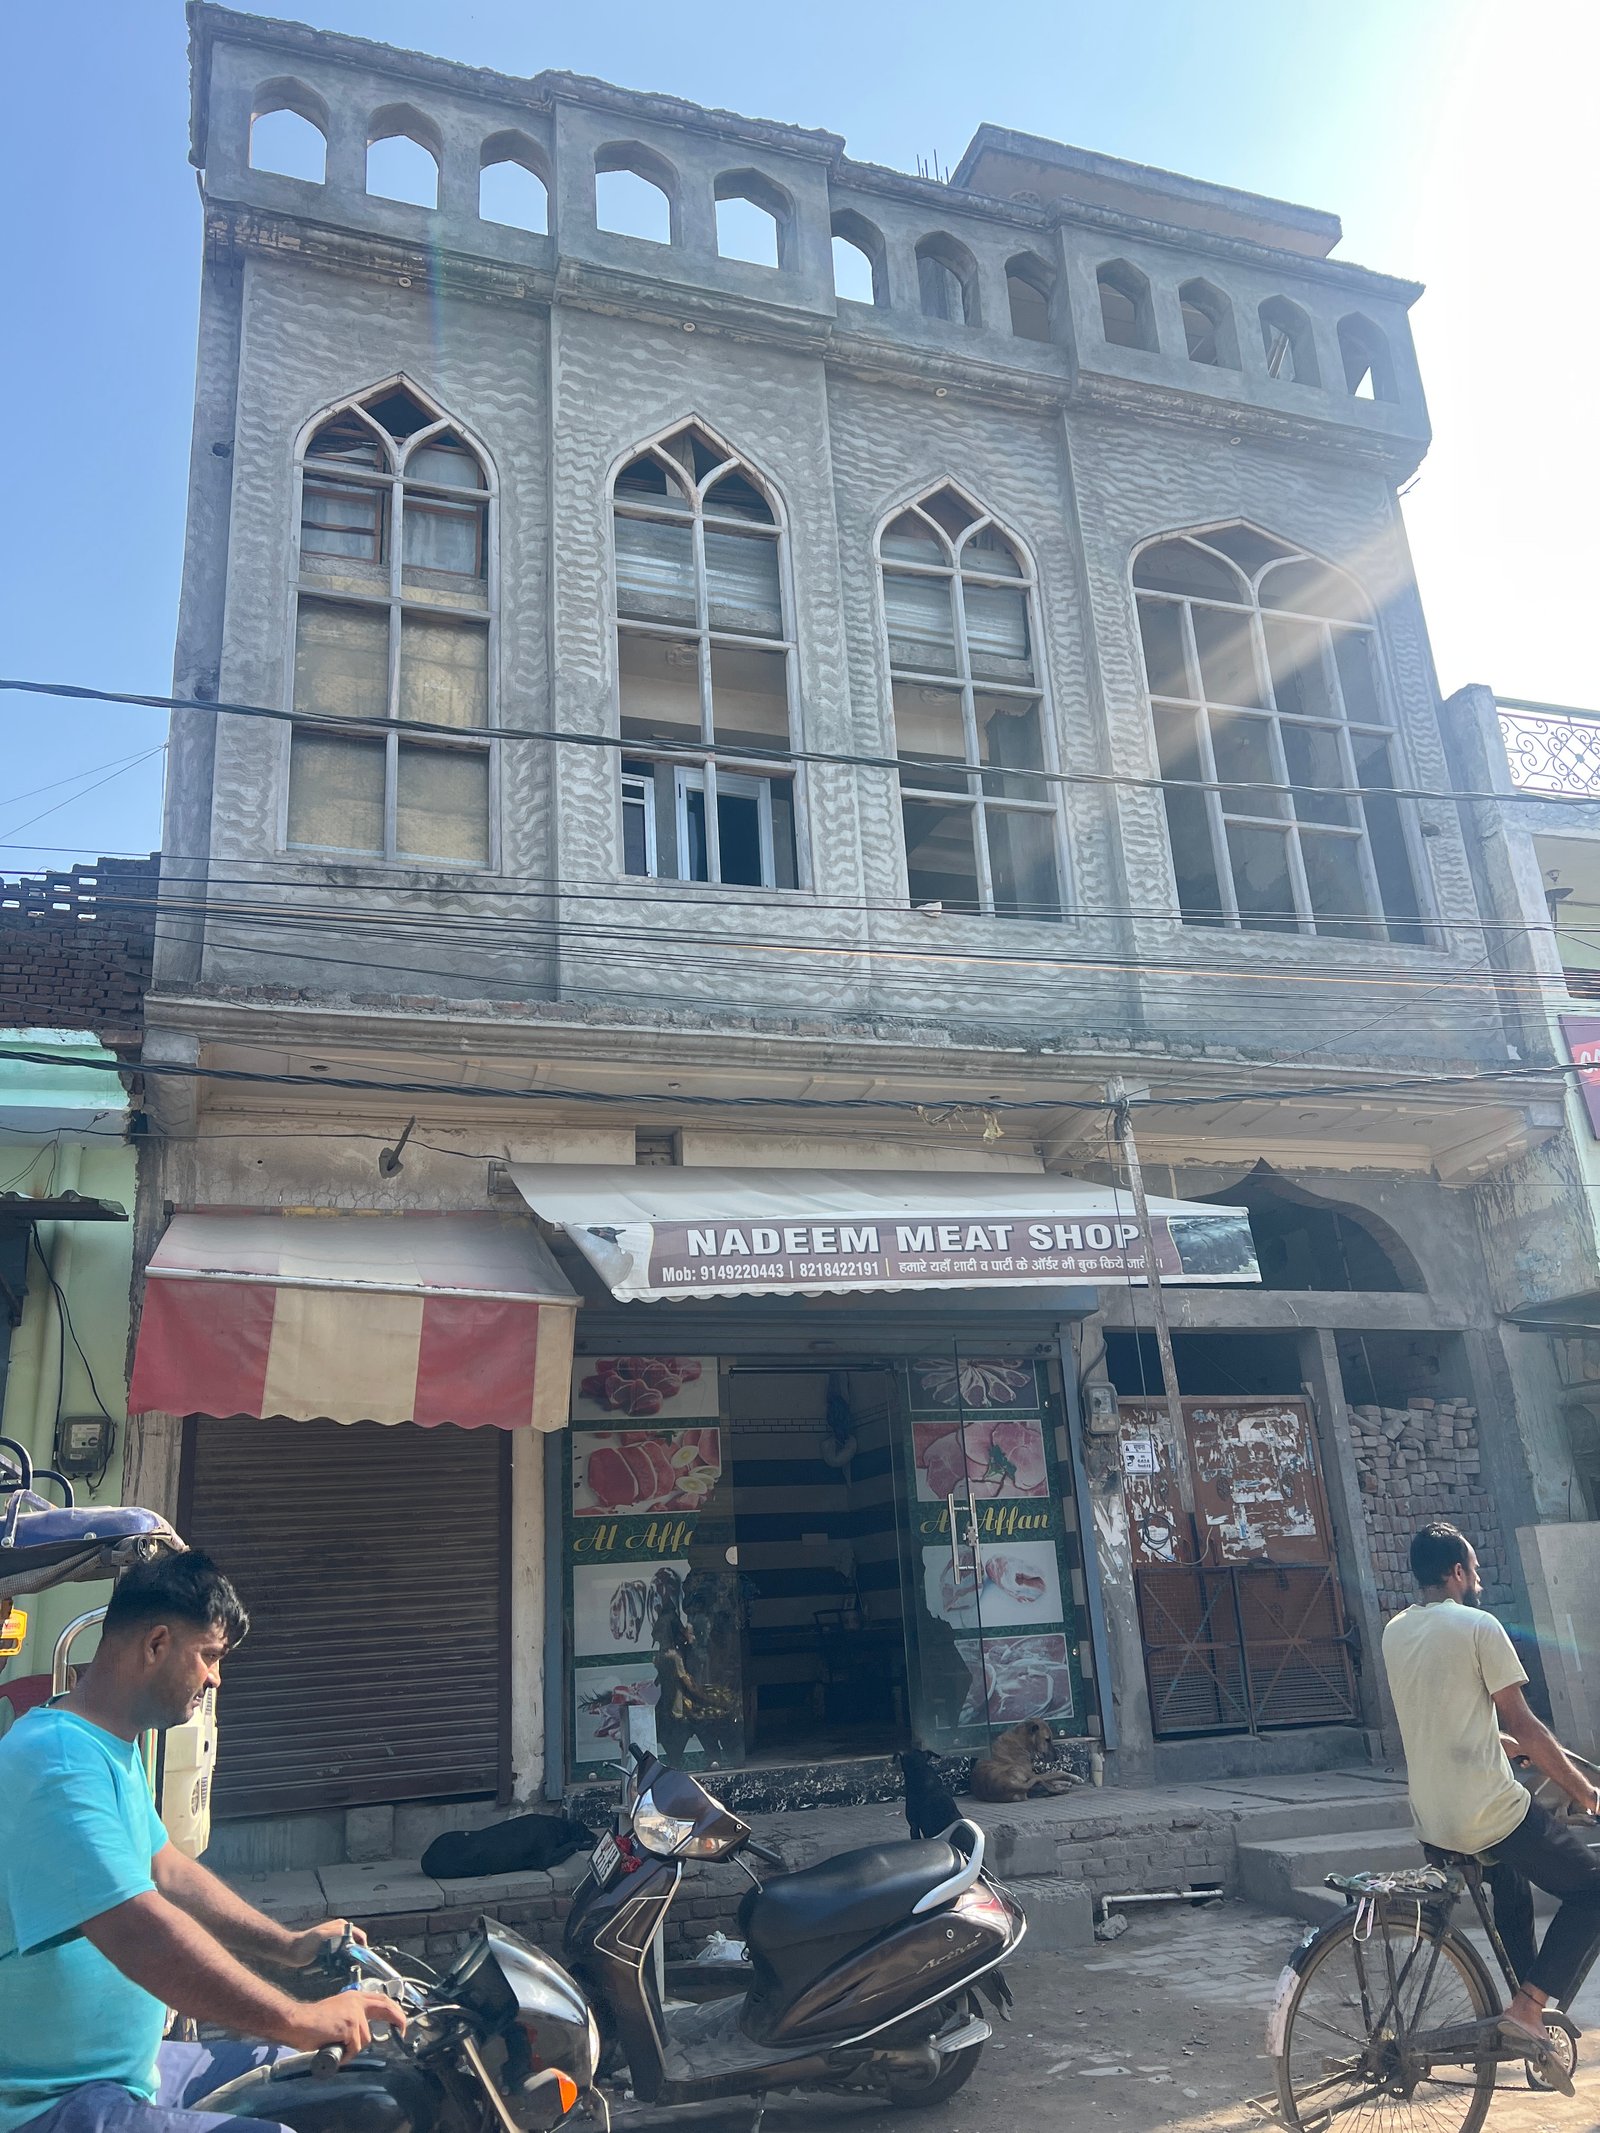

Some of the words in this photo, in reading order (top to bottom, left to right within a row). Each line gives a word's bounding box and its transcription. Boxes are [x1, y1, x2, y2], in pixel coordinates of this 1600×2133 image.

[687, 1227, 881, 1257] NADEEM
[895, 1225, 1014, 1252] MEAT
[1029, 1224, 1140, 1249] SHOP
[662, 1266, 696, 1282] Mob:
[700, 1263, 785, 1280] 9149220443
[800, 1261, 879, 1277] 8218422191
[898, 1258, 927, 1273] हमारे
[930, 1257, 951, 1272] यहाँ
[953, 1257, 977, 1272] शादी
[980, 1260, 989, 1272] व
[991, 1256, 1013, 1271] पार्टी
[1016, 1256, 1028, 1271] के
[1061, 1256, 1076, 1271] भी
[1078, 1258, 1098, 1274] बुक
[920, 1508, 957, 1534] A
[573, 1524, 619, 1552] Al
